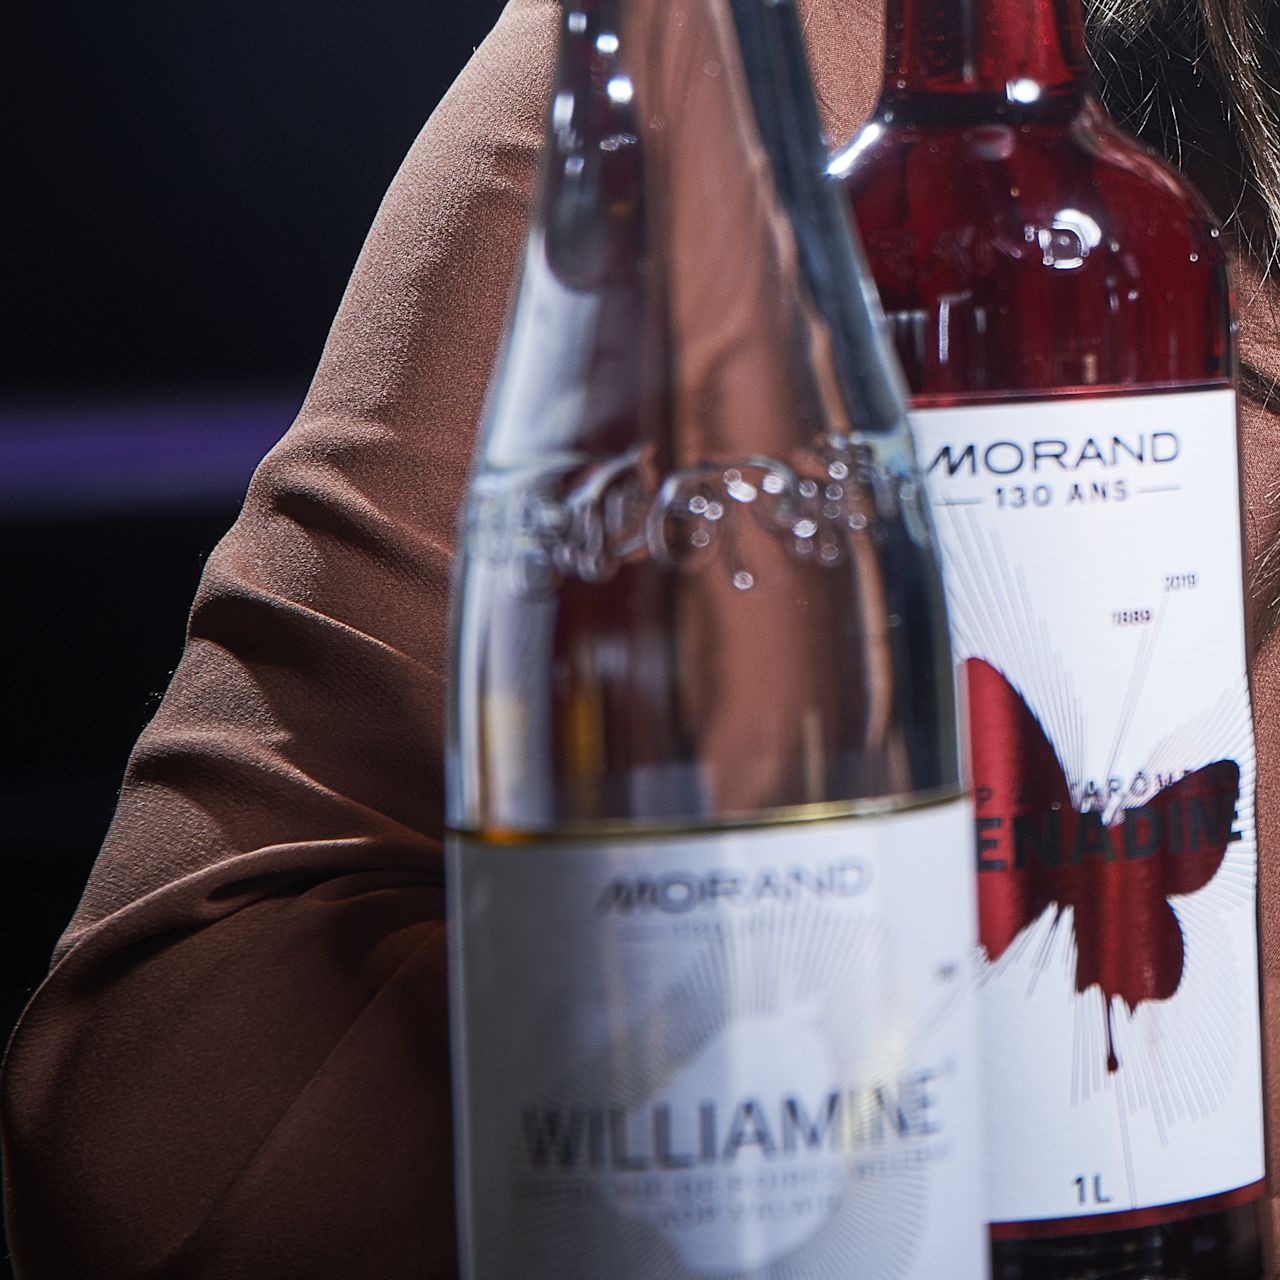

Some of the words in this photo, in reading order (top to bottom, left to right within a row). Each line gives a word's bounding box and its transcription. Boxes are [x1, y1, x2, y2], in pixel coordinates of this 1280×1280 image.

[928, 431, 1179, 476] MORAND
[995, 484, 1053, 509] 130
[1067, 479, 1129, 504] ANS
[976, 790, 1243, 873] ENADINE
[595, 854, 875, 916] MORAND
[1072, 1174, 1112, 1205] 1L
